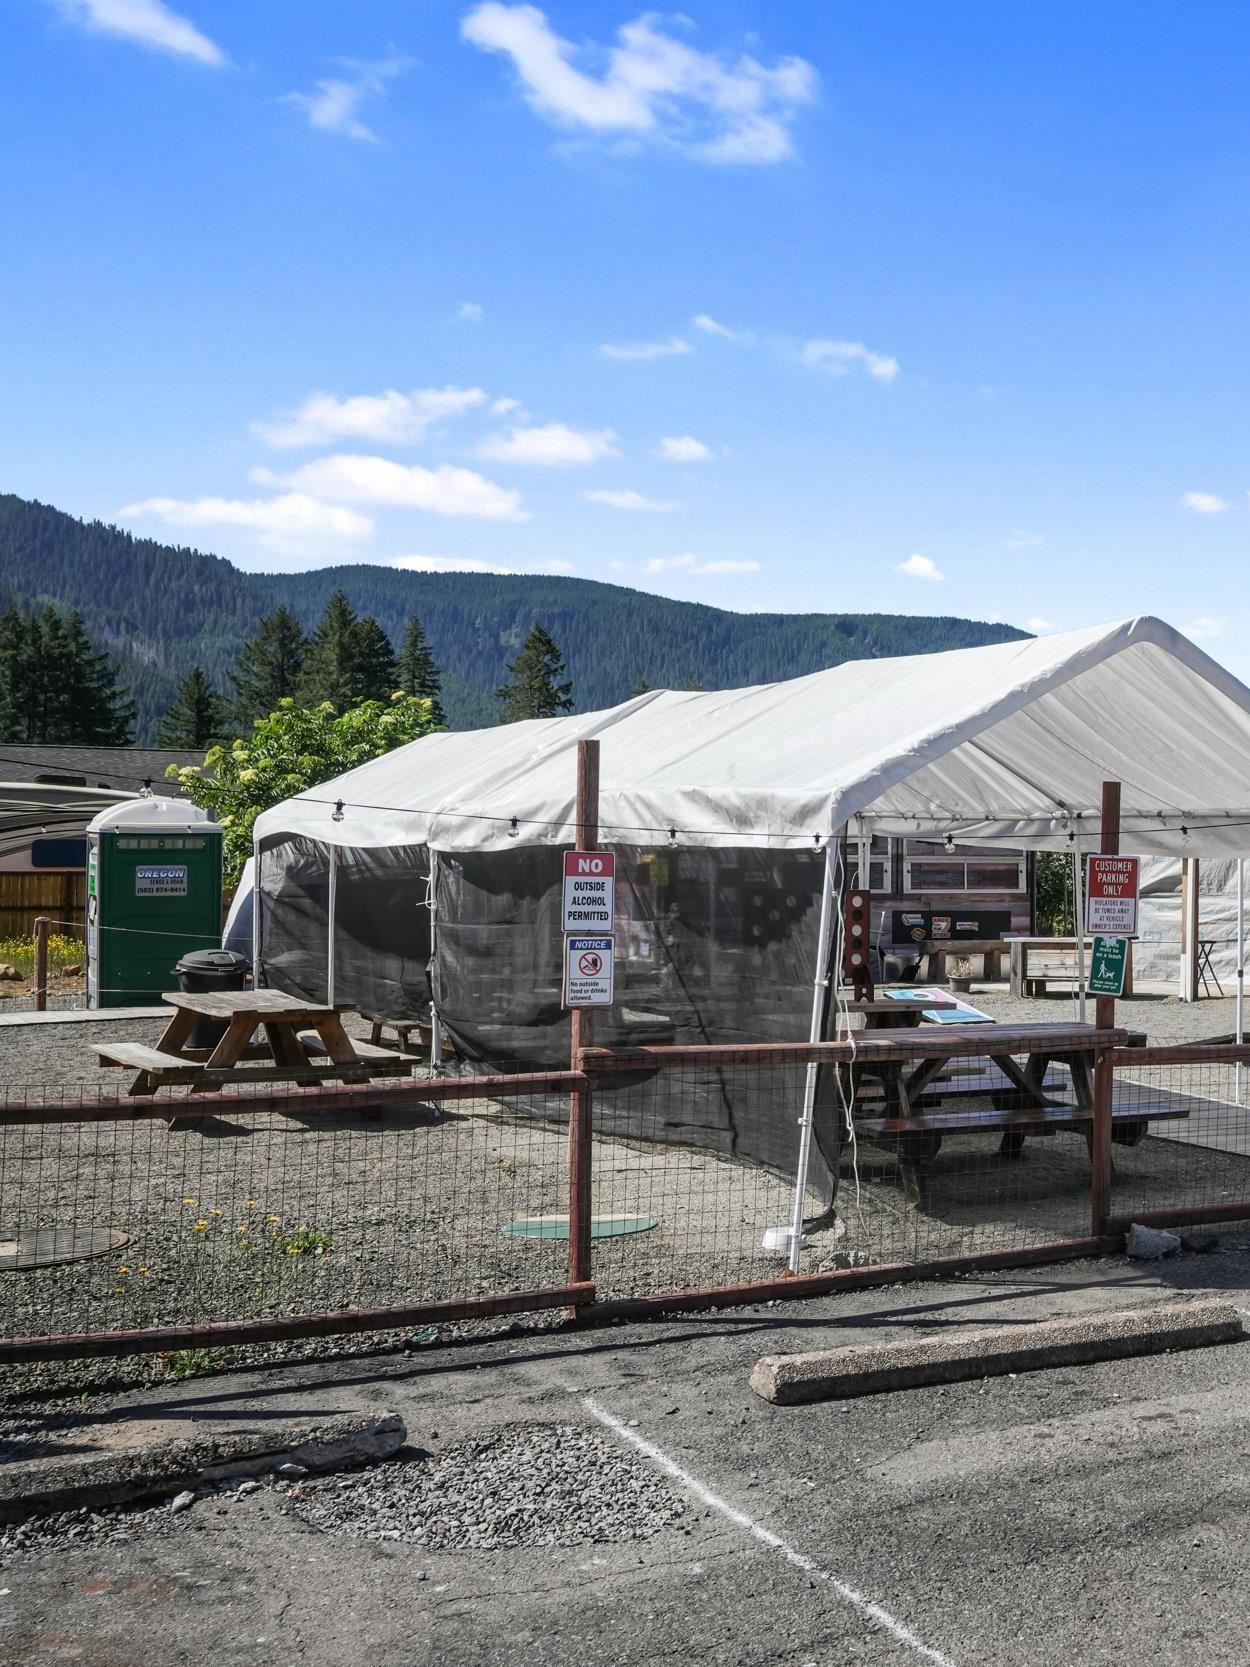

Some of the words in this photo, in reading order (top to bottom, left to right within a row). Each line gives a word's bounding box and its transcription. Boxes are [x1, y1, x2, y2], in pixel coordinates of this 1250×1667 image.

[578, 859, 603, 873] NO
[1095, 861, 1132, 872] CUSTOMER
[137, 868, 185, 878] OREGON
[1097, 873, 1129, 884] PARKING
[574, 881, 605, 891] OUTSIDE
[1103, 885, 1123, 895] ONLY
[571, 896, 606, 906] ALCOHOL
[568, 911, 609, 921] PERMITTED
[575, 941, 607, 949] NOTICE
